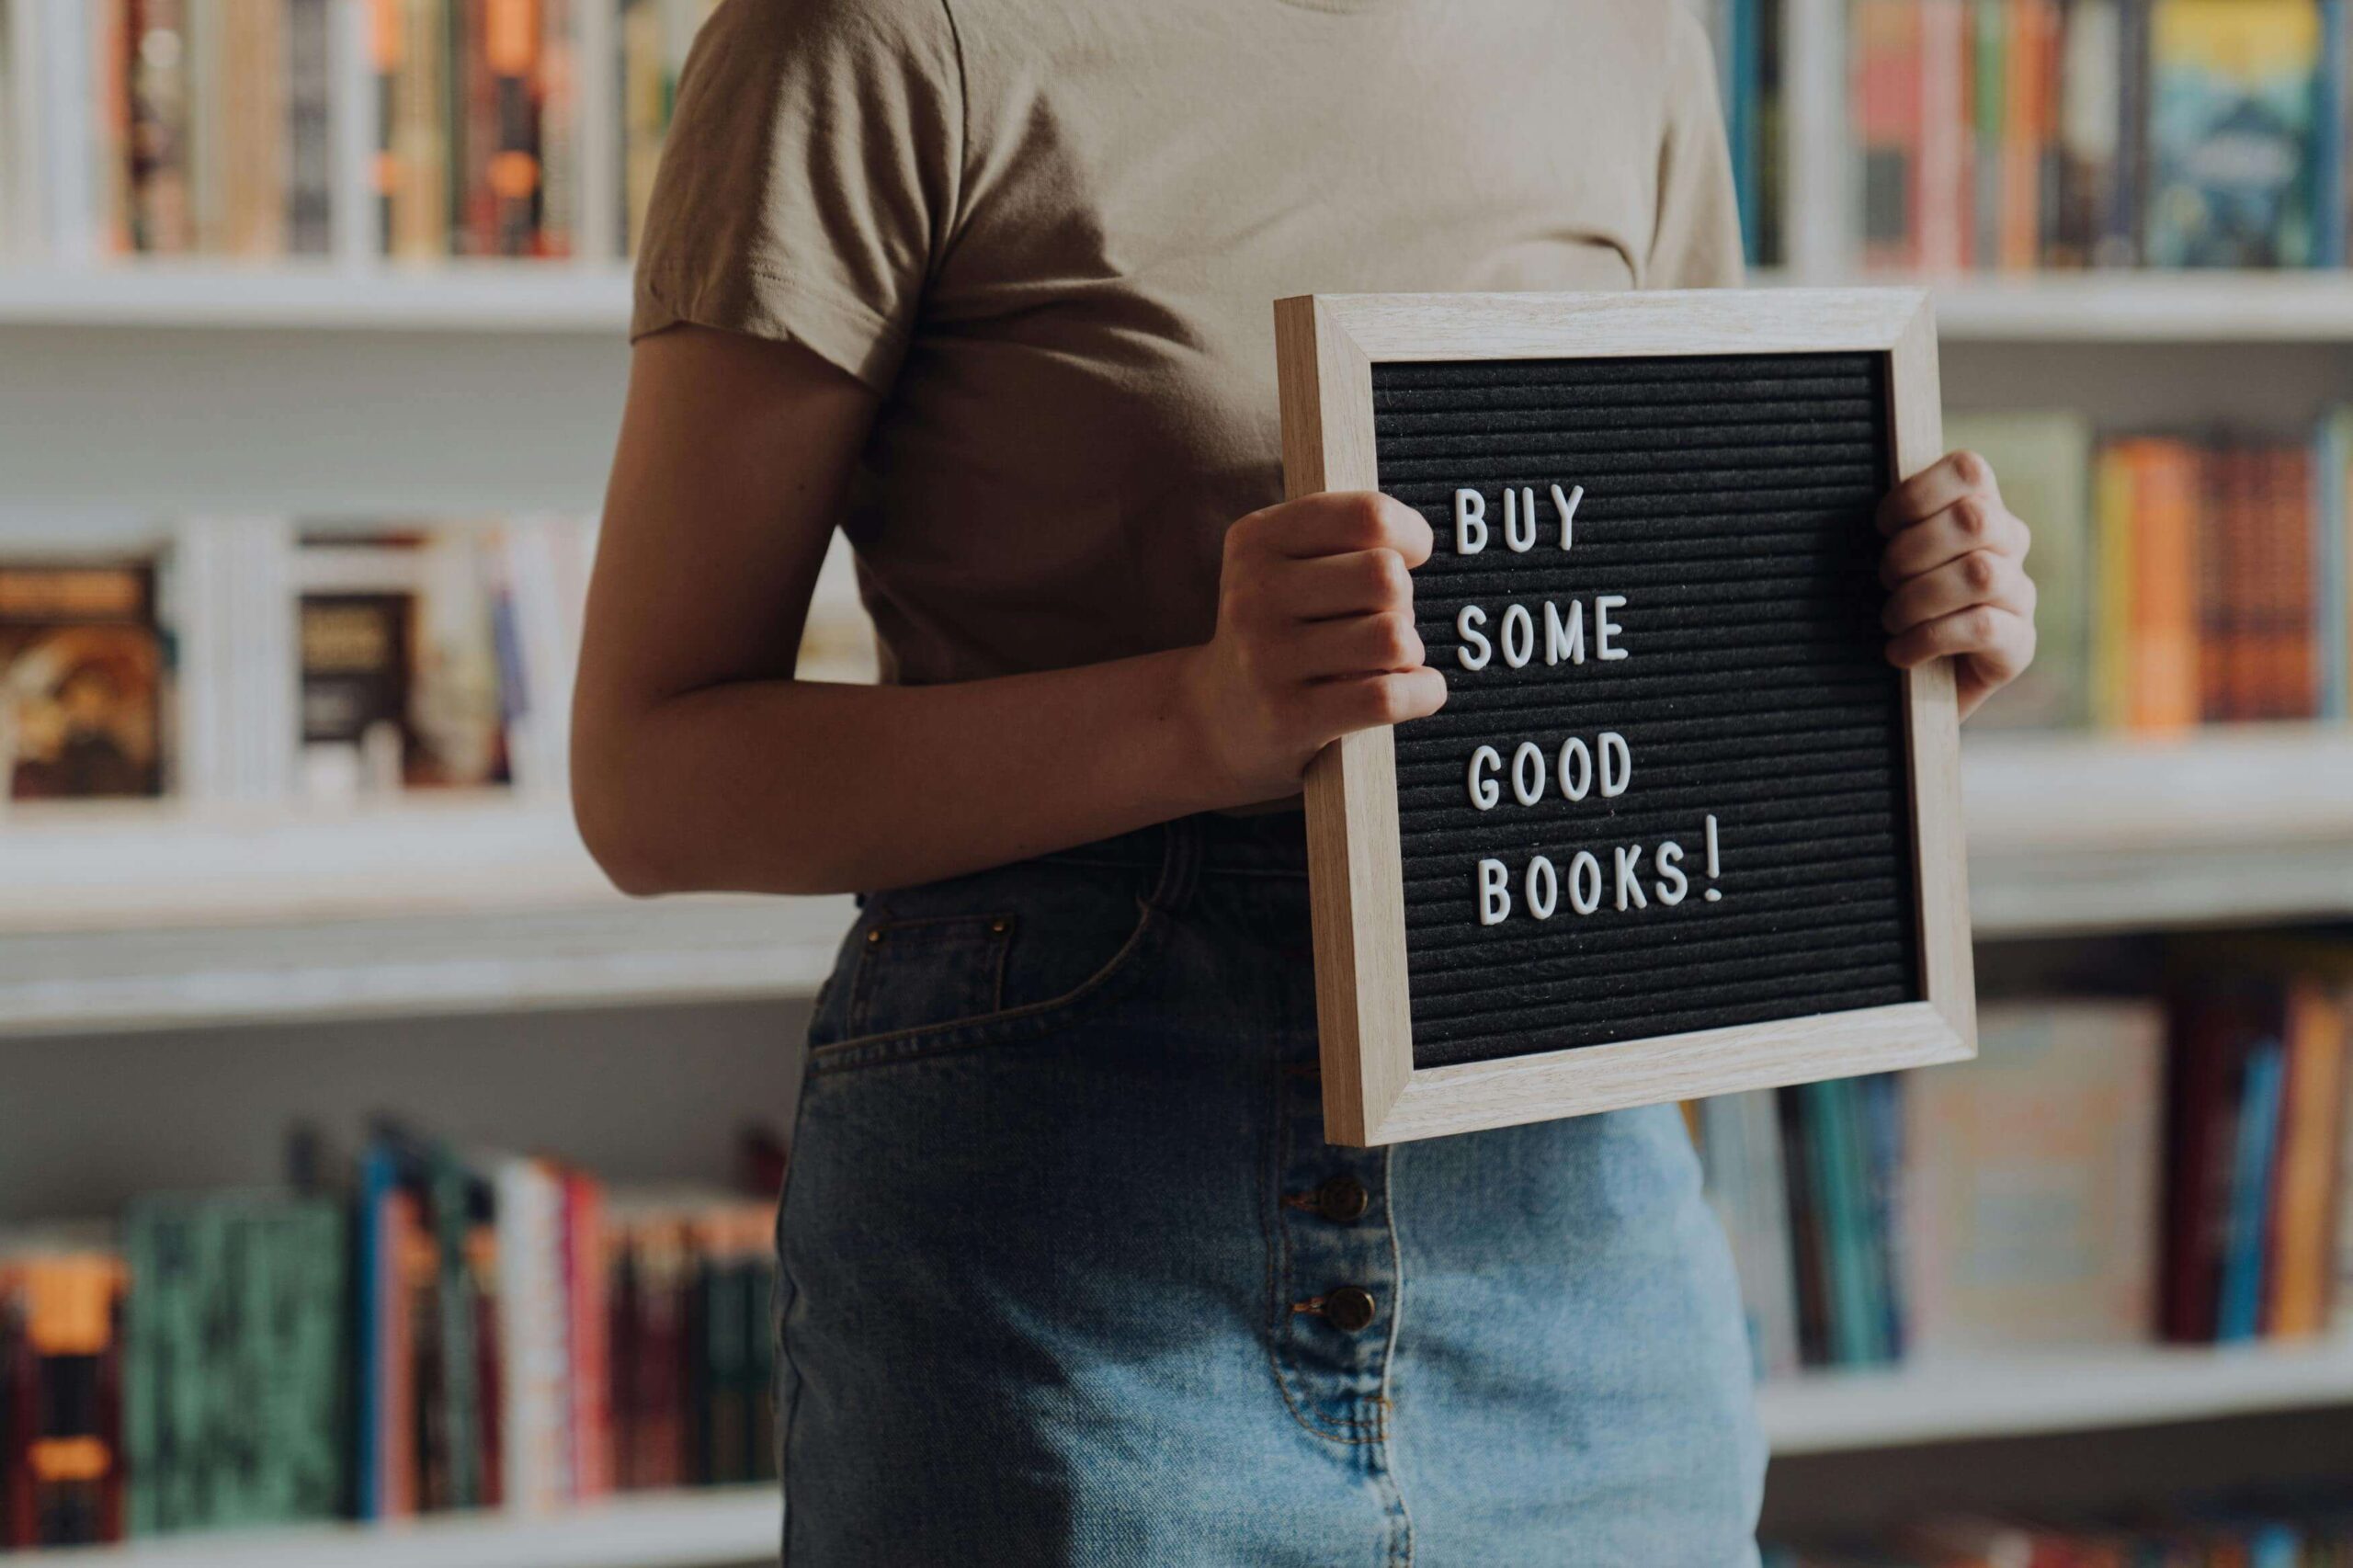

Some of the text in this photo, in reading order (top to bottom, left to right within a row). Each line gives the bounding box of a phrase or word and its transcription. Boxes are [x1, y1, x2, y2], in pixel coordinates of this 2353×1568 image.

[1455, 483, 1585, 555] BUY
[1457, 595, 1630, 671] SOME
[1468, 731, 1632, 811] GOOD
[1478, 813, 1723, 926] BOOKS!
